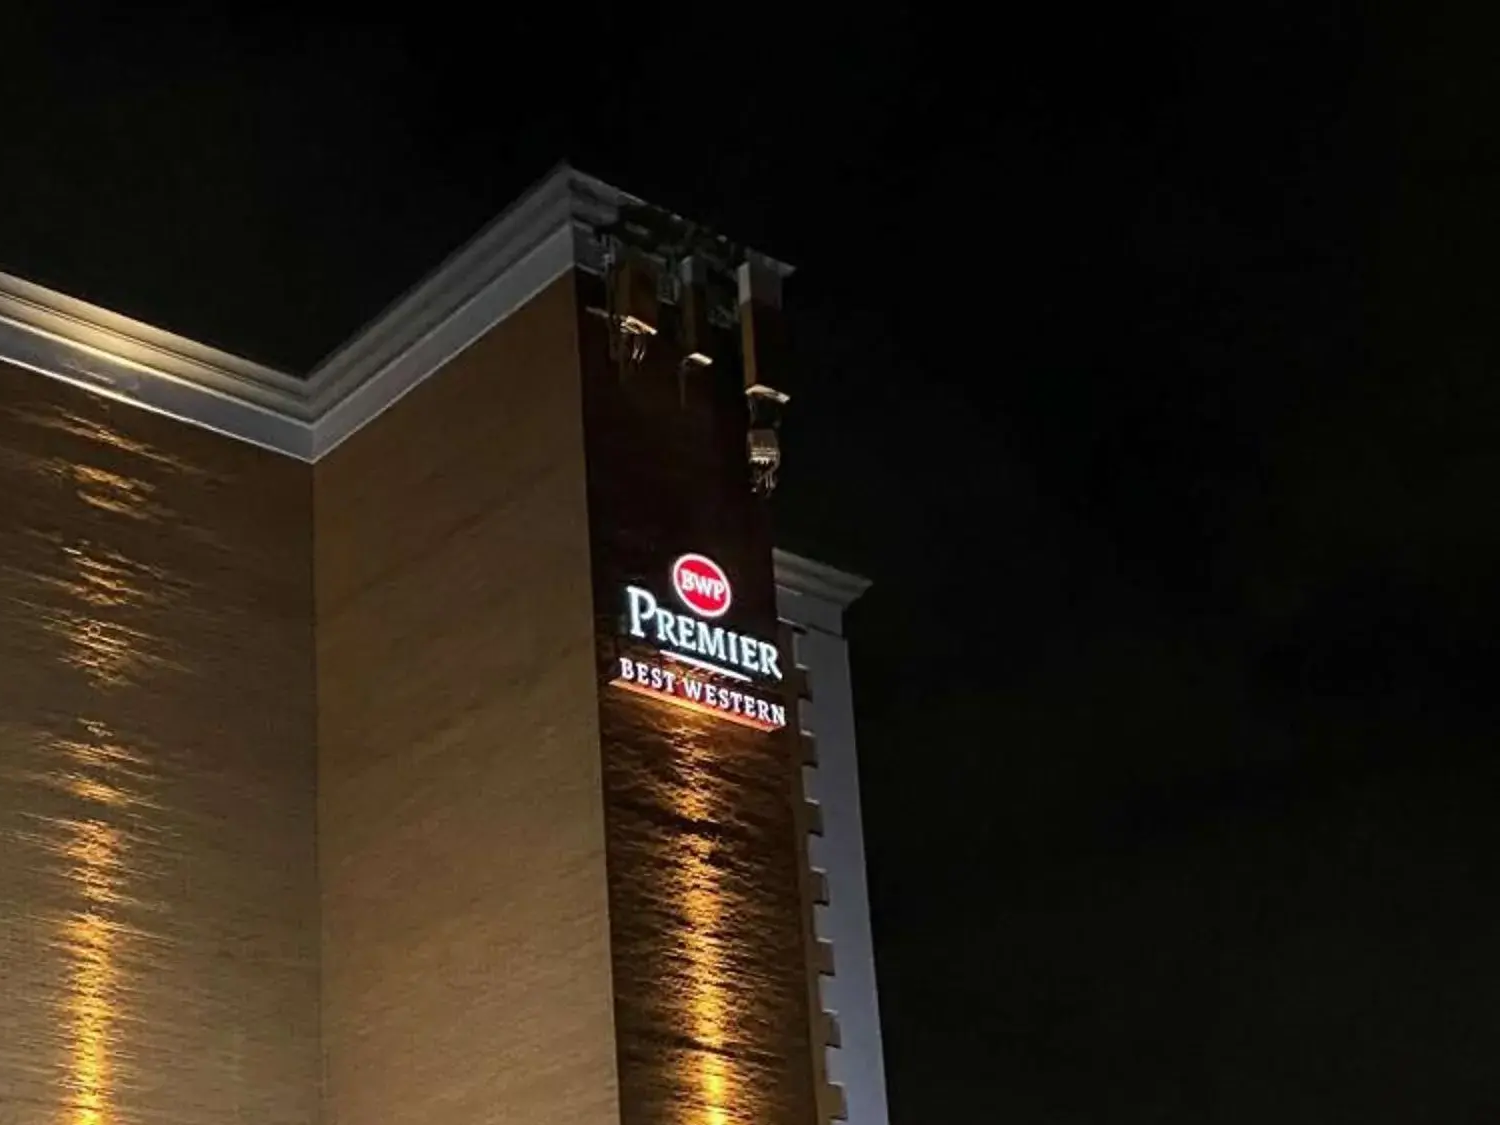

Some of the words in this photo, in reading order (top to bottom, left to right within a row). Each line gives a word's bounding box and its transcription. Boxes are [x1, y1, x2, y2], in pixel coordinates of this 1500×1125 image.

[680, 569, 725, 601] BWP
[626, 585, 783, 681] PREMIER
[619, 657, 677, 694] BEST
[682, 677, 787, 727] WESTERN
